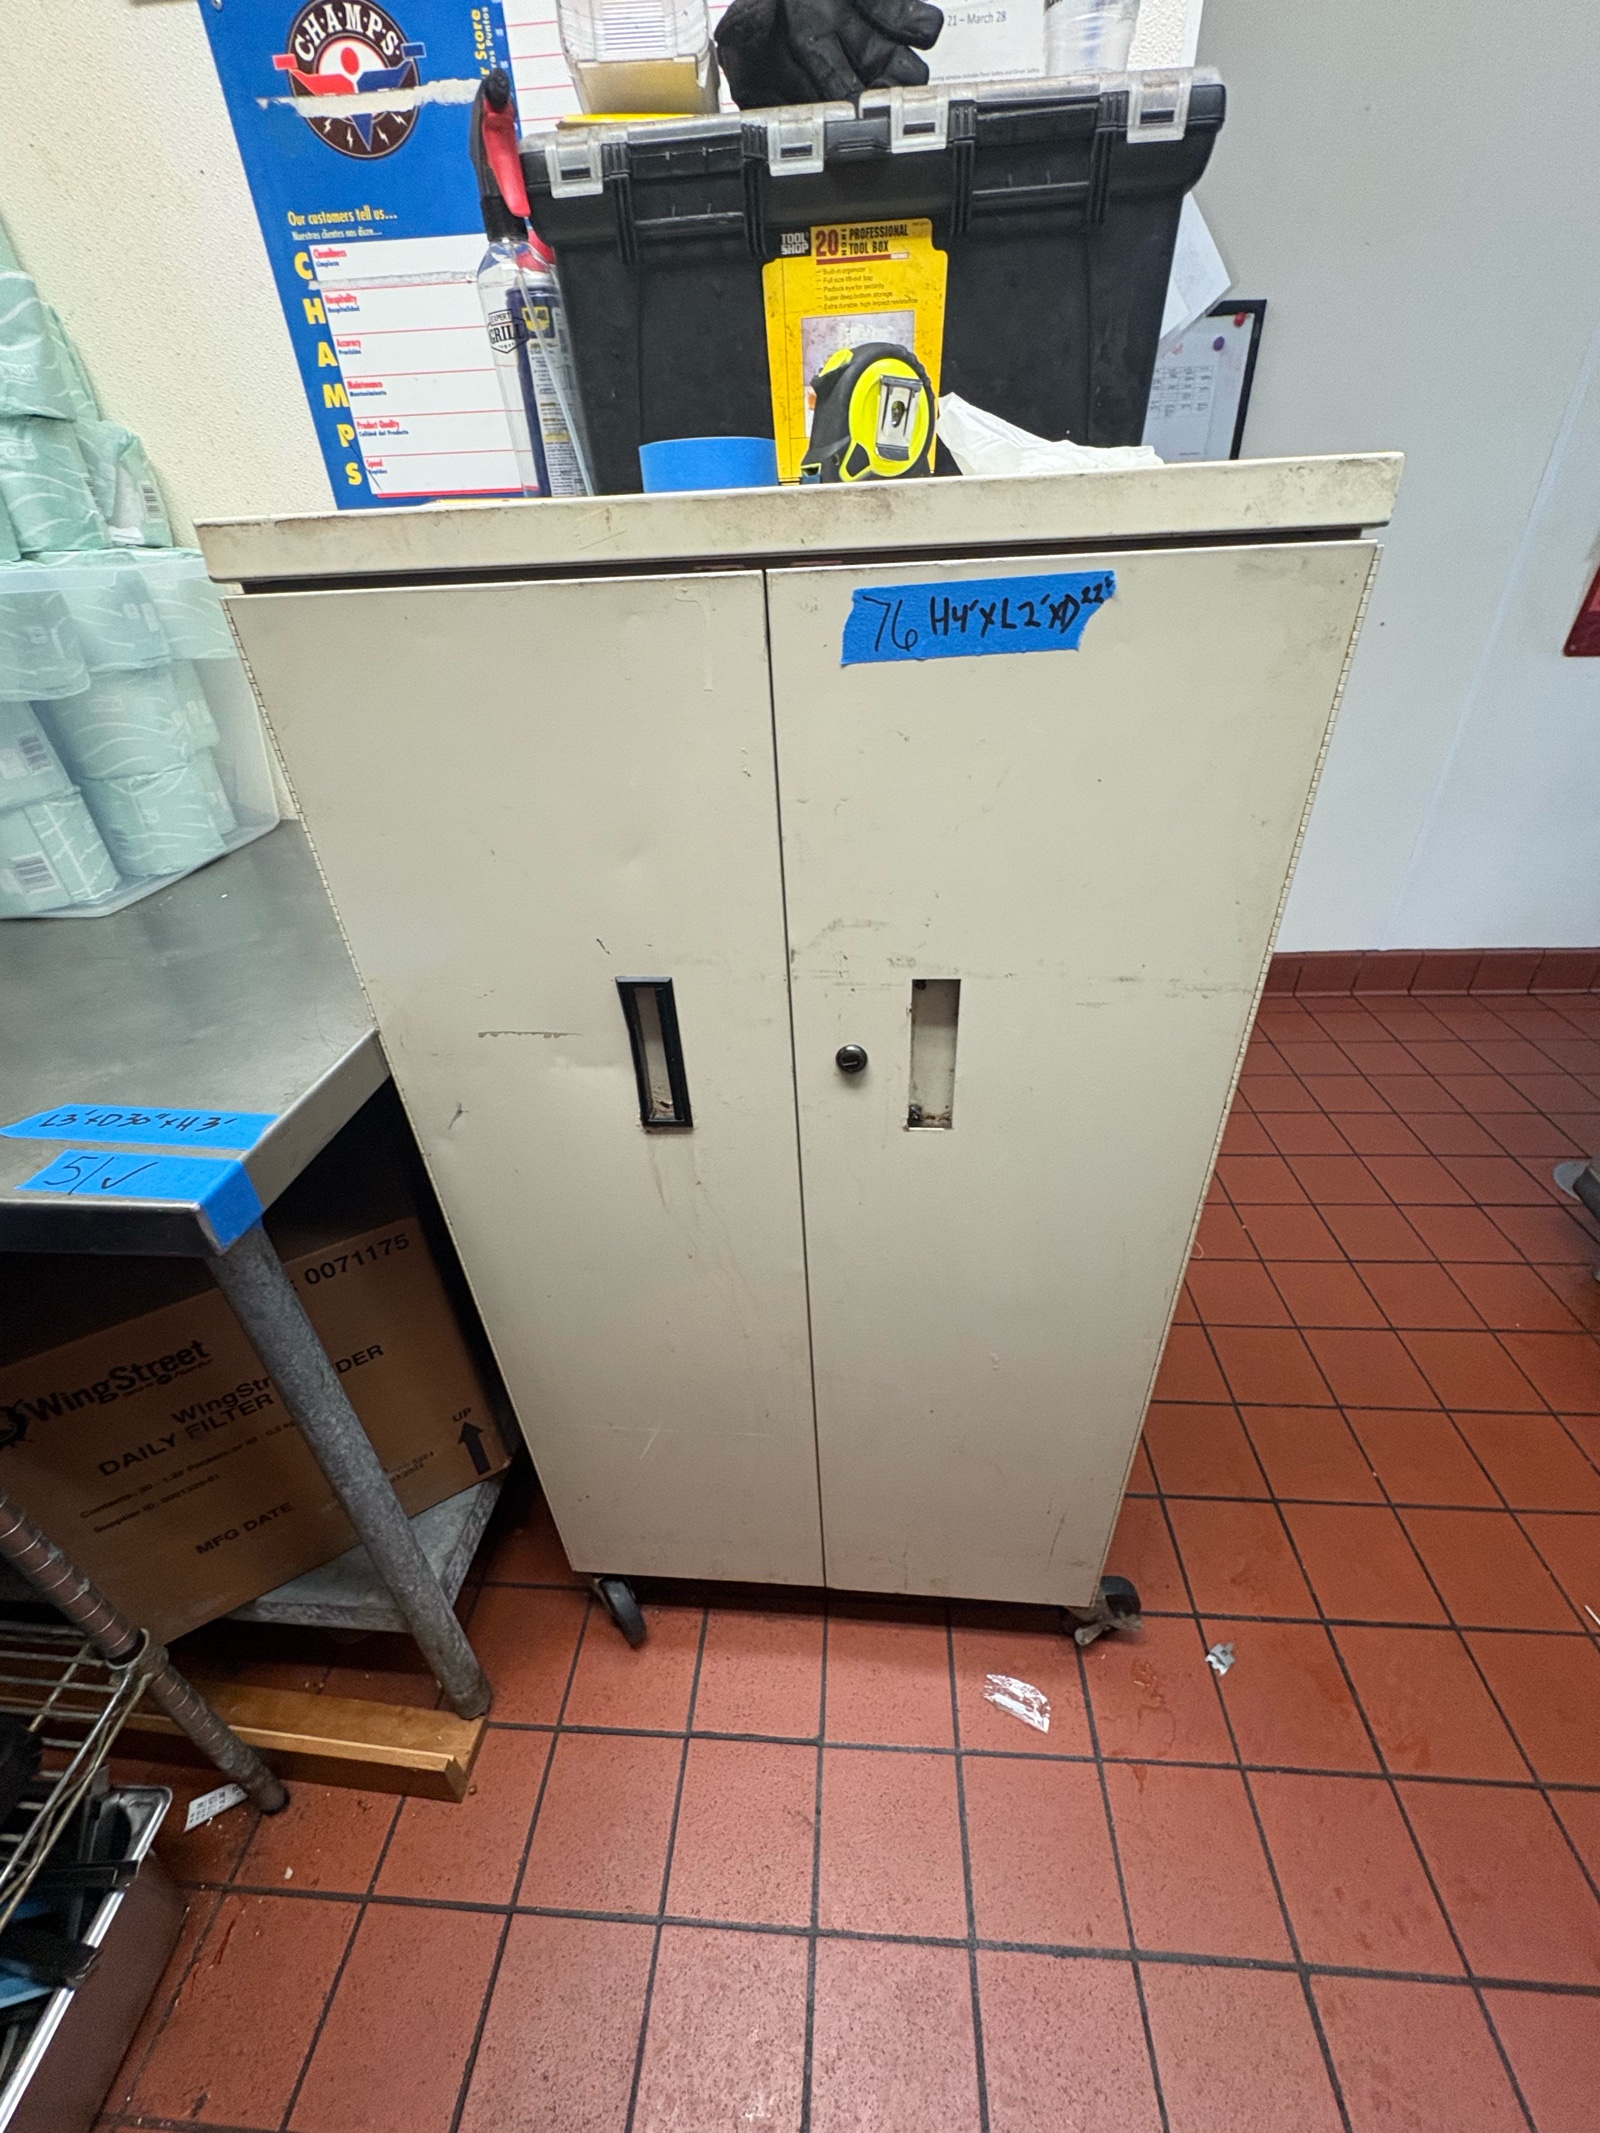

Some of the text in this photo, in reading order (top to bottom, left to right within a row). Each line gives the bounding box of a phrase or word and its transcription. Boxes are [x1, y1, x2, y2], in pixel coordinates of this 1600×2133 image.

[967, 12, 994, 25] March
[996, 11, 1007, 23] 28
[287, 211, 307, 226] Our
[308, 211, 355, 225] customers
[355, 205, 373, 221] tell
[781, 231, 807, 245] TOOL
[849, 224, 909, 240] PROFESSIONAL
[781, 242, 810, 255] SHOP
[815, 229, 839, 257] 20
[849, 240, 889, 255] TOOL BOX
[861, 595, 919, 652] 76
[304, 1232, 411, 1286] 0071175
[24, 1339, 211, 1422] WingStreet
[452, 1406, 473, 1423] UP
[97, 1432, 177, 1477] DAILY
[185, 1393, 275, 1440] FILTER
[194, 1501, 295, 1555] MFG DATE
